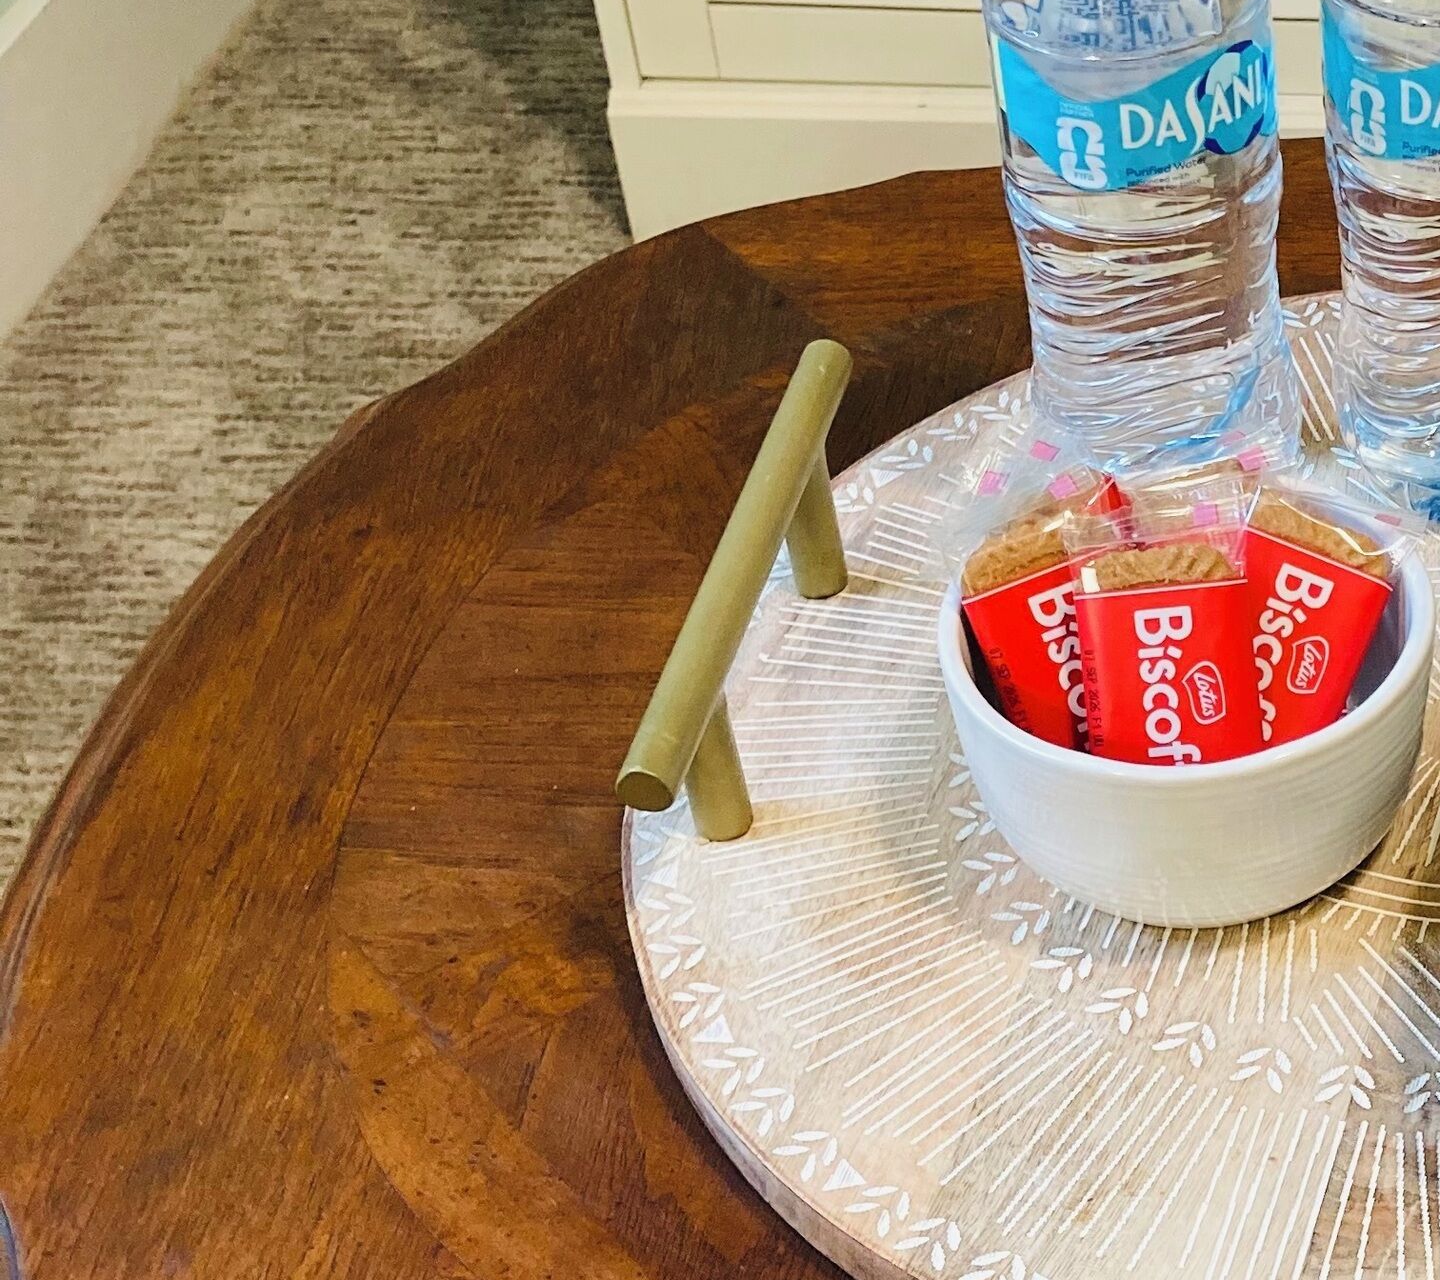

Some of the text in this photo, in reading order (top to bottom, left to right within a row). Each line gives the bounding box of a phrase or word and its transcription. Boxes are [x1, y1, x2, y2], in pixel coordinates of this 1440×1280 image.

[1119, 57, 1263, 155] DASANI
[1074, 171, 1095, 181] FIFA
[1126, 155, 1207, 178] Purified Water
[1027, 578, 1090, 753] Bisco
[1252, 562, 1335, 742] Bisco
